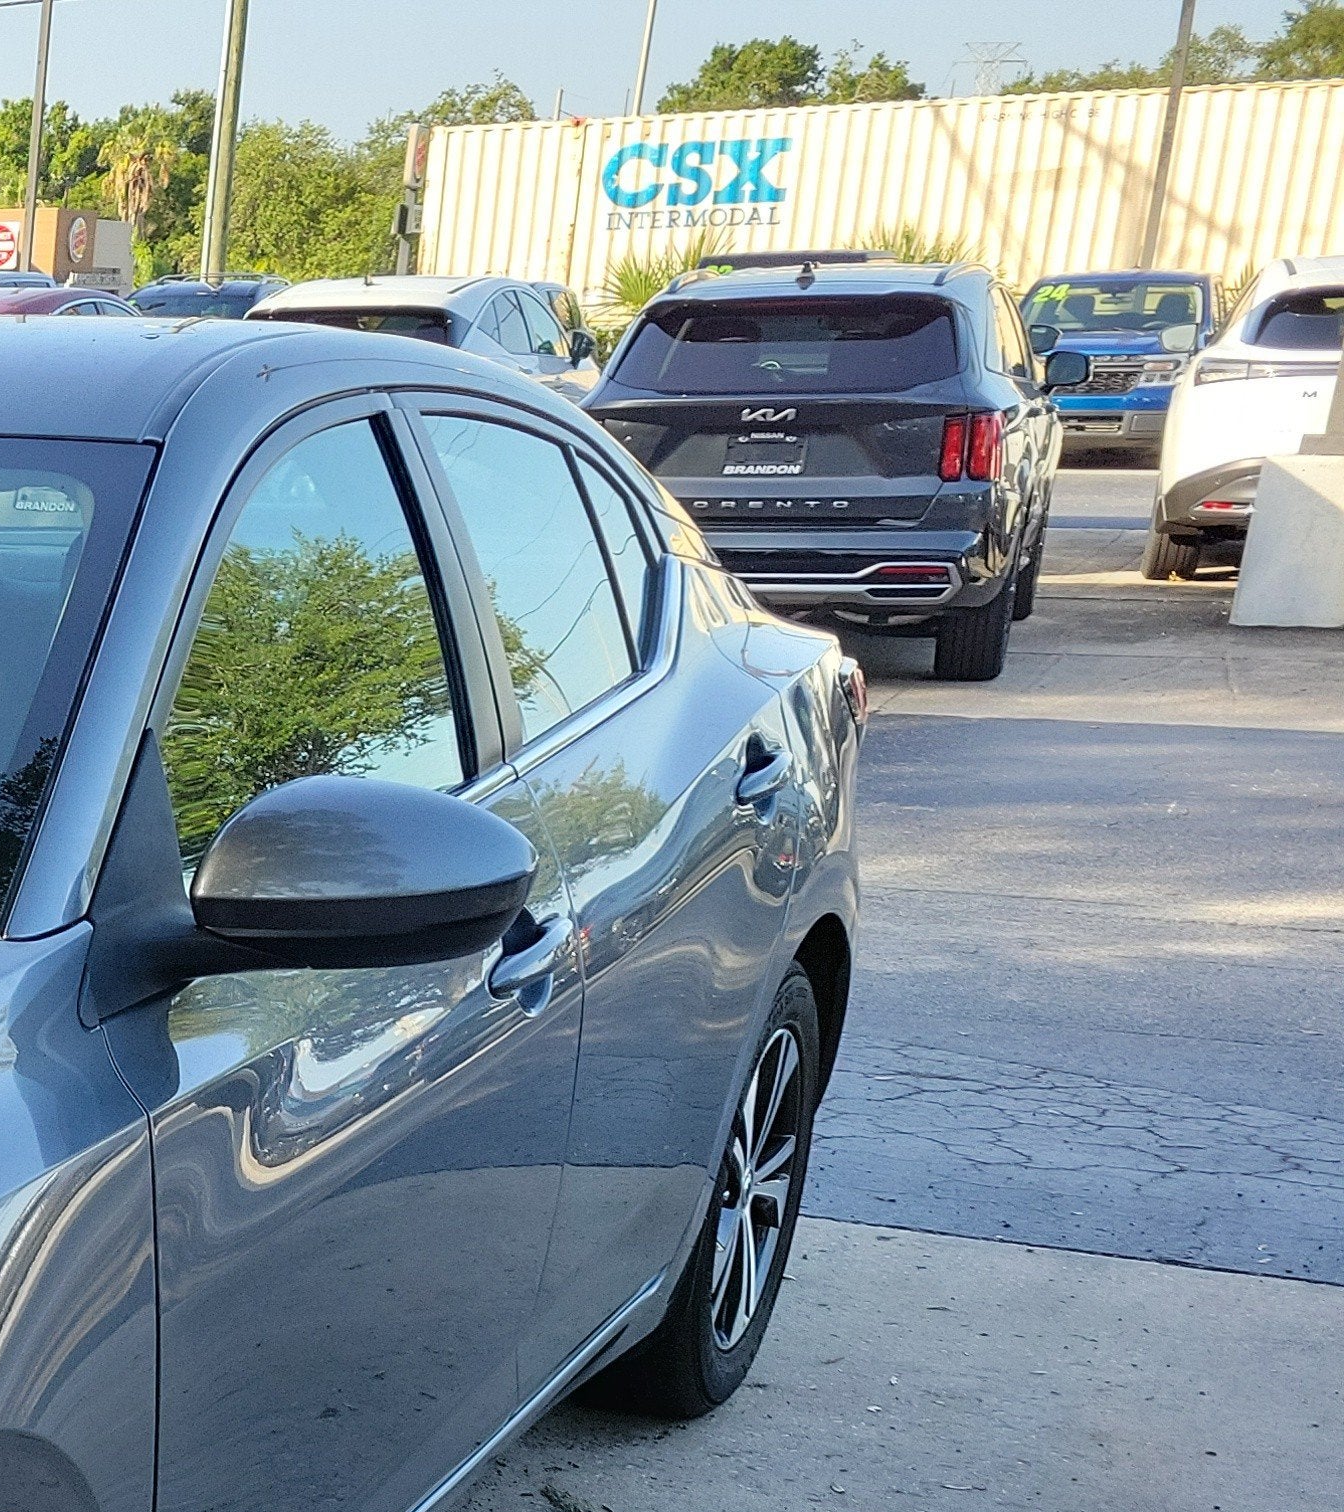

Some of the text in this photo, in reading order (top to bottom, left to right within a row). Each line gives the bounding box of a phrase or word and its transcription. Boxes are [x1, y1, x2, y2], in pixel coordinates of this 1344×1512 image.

[1070, 108, 1101, 118] CBE
[602, 138, 792, 208] CSX
[606, 207, 781, 230] INTERMODAL
[1033, 283, 1070, 303] 24
[722, 465, 801, 475] BRANDON
[15, 501, 75, 512] BRANDON
[693, 501, 849, 509] ORENTO
